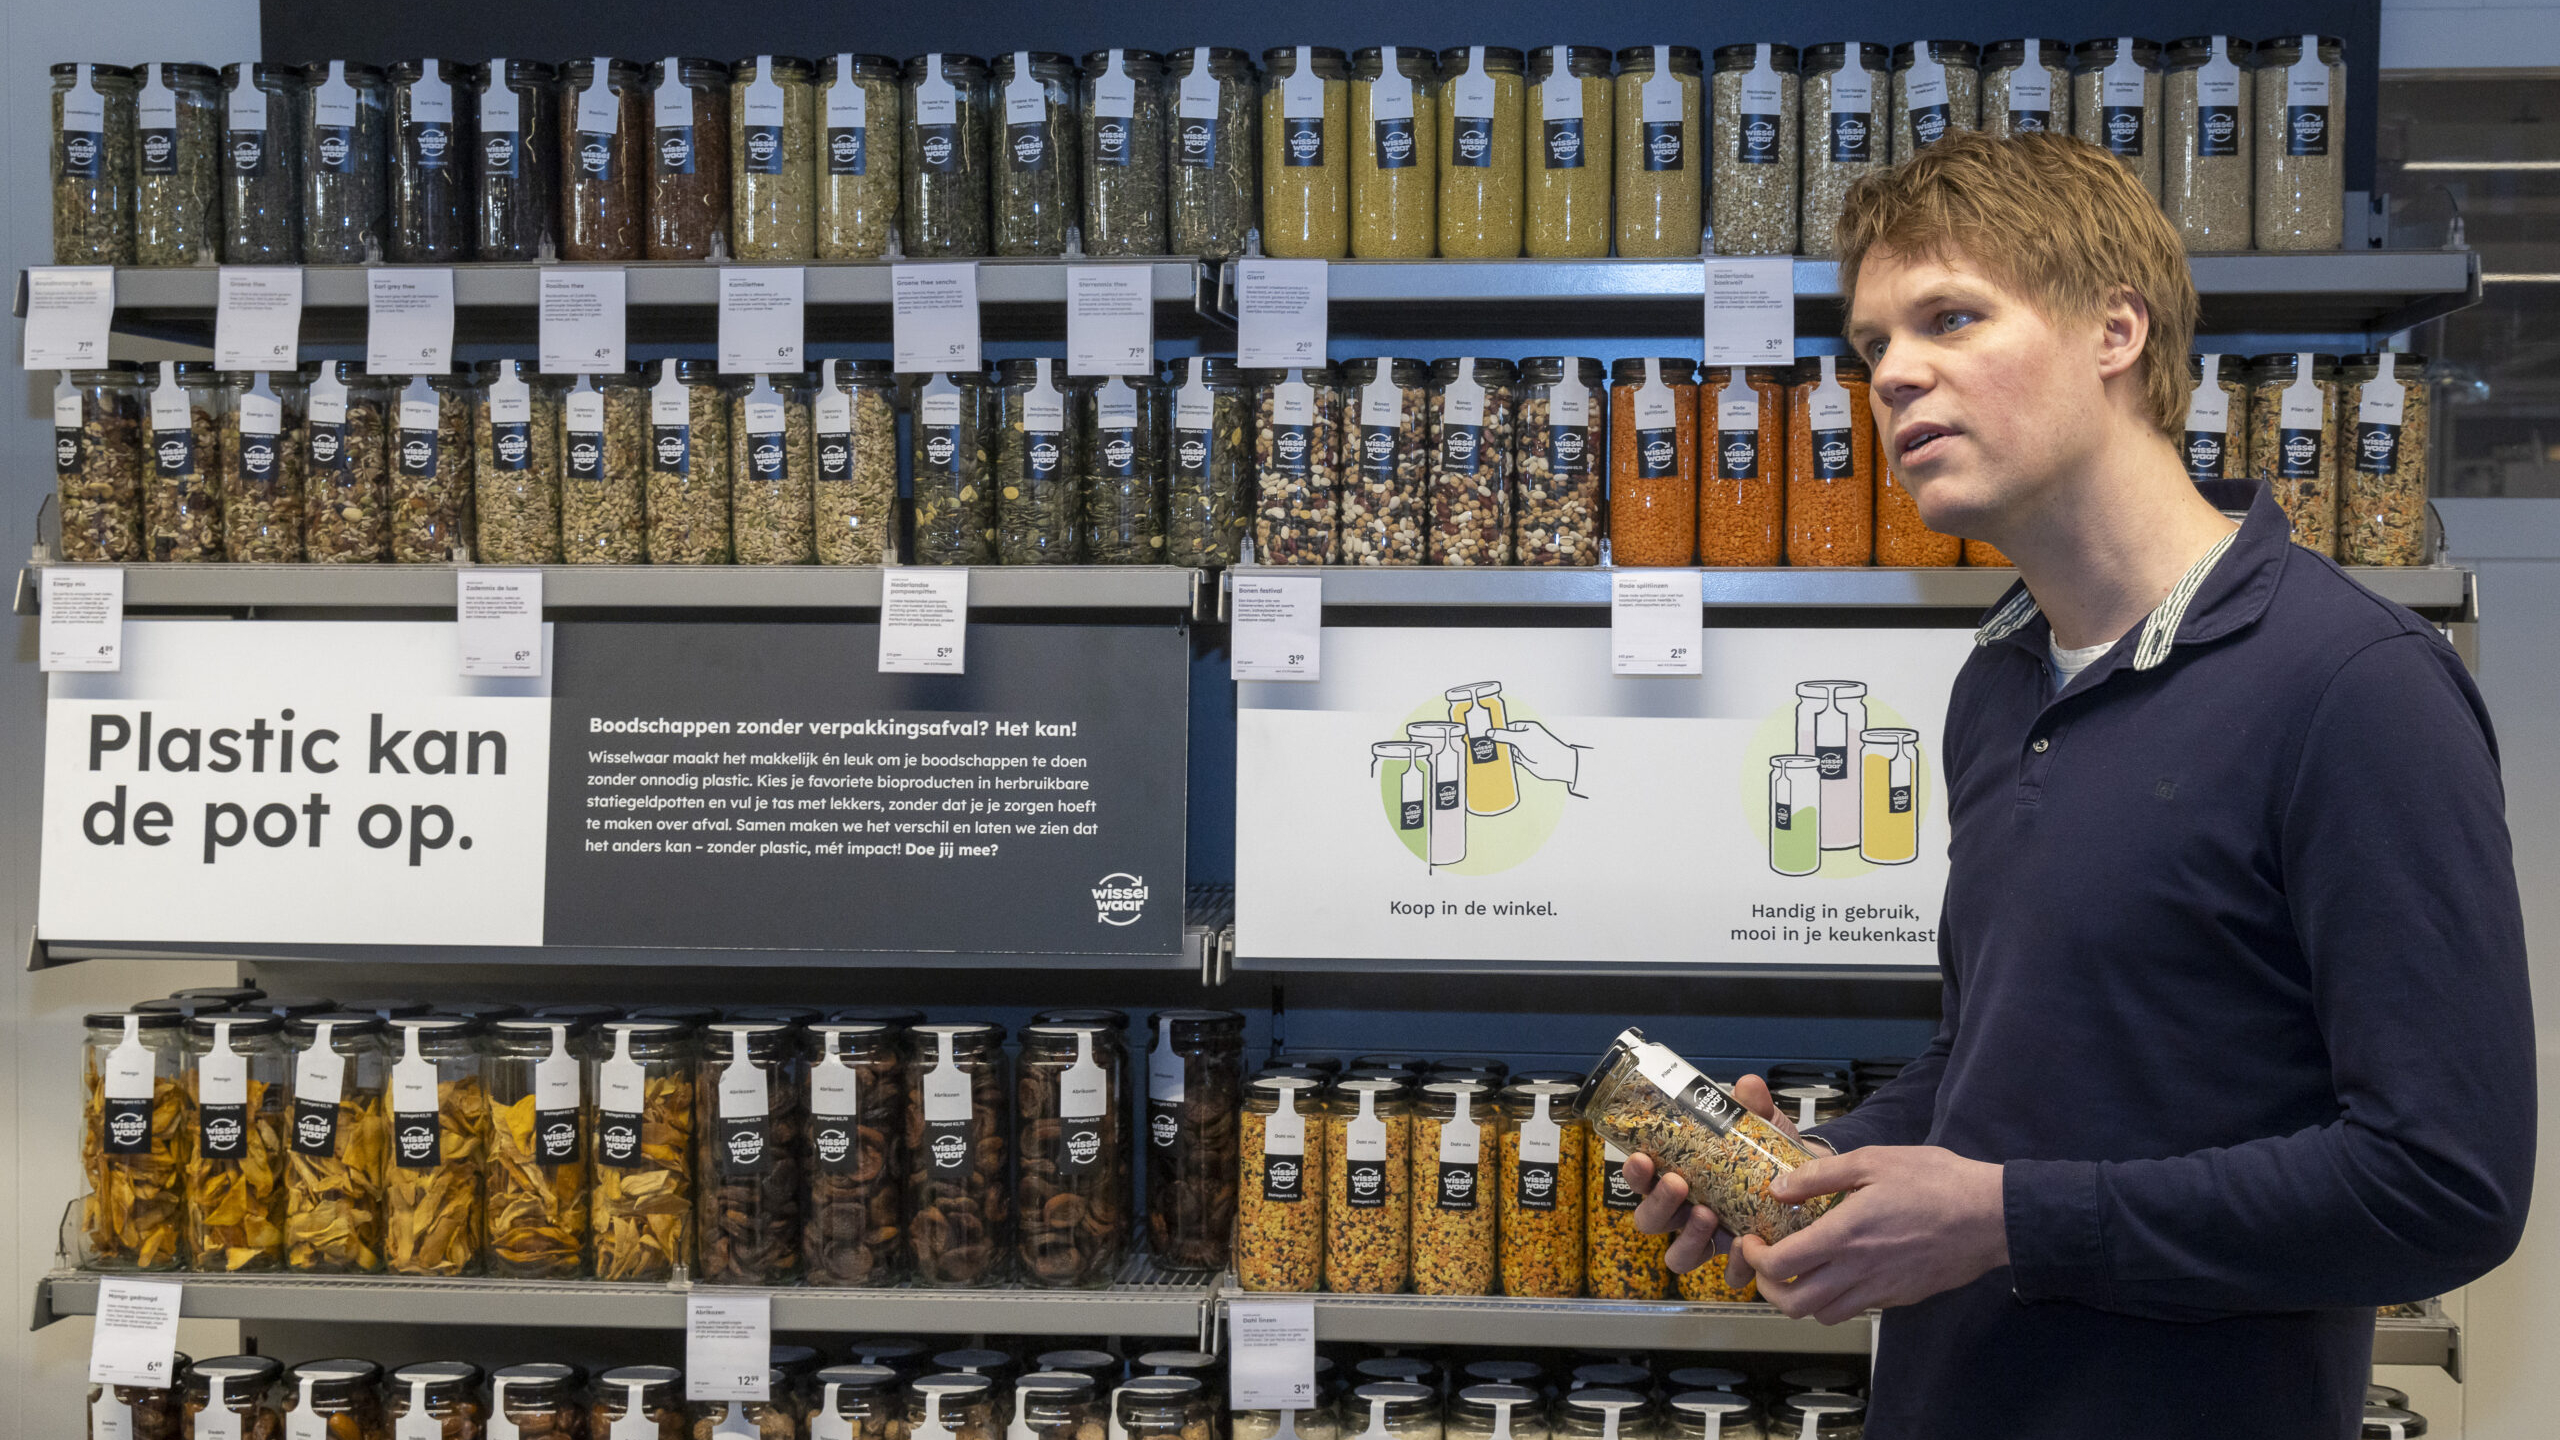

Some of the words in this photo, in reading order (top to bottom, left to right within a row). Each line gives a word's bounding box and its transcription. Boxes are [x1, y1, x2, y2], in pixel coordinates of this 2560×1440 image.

[1291, 136, 1320, 145] wissel
[1277, 437, 1307, 447] wissel
[2285, 442, 2316, 452] wissel
[1644, 447, 1674, 456] wissel
[1647, 454, 1672, 462] waar
[590, 717, 730, 737] Boodschappen
[736, 718, 803, 734] zonder
[808, 718, 988, 739] verpakkingsafval?
[995, 720, 1029, 736] Het
[1035, 720, 1076, 736] kan!
[89, 708, 339, 773] Plastic
[369, 713, 506, 774] kan
[588, 750, 669, 763] Wisselwaar
[673, 751, 719, 764] maakt
[723, 751, 746, 764] het
[750, 752, 818, 767] makkelijk
[822, 752, 839, 765] én
[844, 752, 873, 765] leuk
[877, 756, 900, 765] om
[903, 753, 917, 768] je
[921, 753, 1027, 770] boodschappen
[1032, 755, 1046, 767] te
[1050, 754, 1086, 767] doen
[587, 772, 636, 785] zonder
[640, 773, 698, 789] onnodig
[702, 773, 752, 789] plastic.
[757, 774, 787, 787] Kies
[790, 774, 804, 790] je
[808, 774, 873, 787] favoriete
[877, 774, 973, 791] bioproducten
[978, 776, 990, 788] in
[995, 776, 1089, 790] herbruikbare
[586, 794, 704, 811] statiegeldpotten
[708, 798, 726, 808] en
[730, 796, 751, 808] vul
[754, 796, 768, 811] je
[772, 797, 794, 809] tas
[798, 798, 826, 809] met
[830, 796, 884, 812] lekkers,
[888, 798, 938, 810] zonder
[941, 798, 966, 810] dat
[969, 798, 983, 814] je
[986, 798, 1000, 814] je
[1004, 802, 1053, 815] zorgen
[1058, 799, 1096, 812] hoeft
[83, 785, 172, 846] de
[203, 793, 330, 863] pot
[358, 804, 472, 866] op.
[586, 817, 600, 829] te
[604, 817, 652, 830] maken
[656, 820, 688, 830] over
[692, 817, 732, 830] afval.
[736, 818, 785, 831] Samen
[790, 819, 838, 832] maken
[842, 822, 862, 832] we
[866, 820, 890, 832] het
[894, 820, 948, 833] verschil
[952, 823, 970, 833] en
[975, 820, 1010, 833] laten
[1015, 824, 1036, 834] we
[1040, 821, 1068, 834] zien
[1073, 822, 1098, 834] dat
[585, 839, 608, 851] het
[612, 839, 661, 852] anders
[665, 839, 691, 852] kan
[707, 840, 756, 853] zonder
[760, 840, 810, 856] plastic,
[815, 841, 843, 854] mét
[847, 841, 900, 857] impact!
[905, 843, 935, 855] Doe
[938, 842, 953, 858] jij
[958, 843, 998, 856] mee?
[1091, 883, 1149, 900] wissel
[1096, 900, 1144, 911] waar
[1390, 901, 1434, 918] Koop
[1442, 900, 1456, 914] in
[1464, 900, 1486, 915] de
[1492, 900, 1556, 916] winkel.
[1752, 903, 1815, 922] Handig
[1822, 903, 1837, 918] in
[1845, 904, 1919, 922] gebruik,
[1731, 926, 1775, 940] mooi
[1783, 926, 1798, 940] in
[1804, 926, 1821, 944] je
[1695, 1087, 1719, 1110] wissel
[1703, 1094, 1723, 1113] waar
[110, 1119, 147, 1129] wissel
[113, 1128, 144, 1137] waar
[400, 1133, 434, 1143] wissel
[403, 1142, 431, 1150] waar
[728, 1137, 764, 1148] wissel
[931, 1142, 967, 1152] wissel
[731, 1146, 761, 1156] waar
[935, 1151, 964, 1159] waar
[1269, 1167, 1298, 1176] wissel
[1523, 1174, 1553, 1184] wissel
[1525, 1182, 1551, 1190] waar
